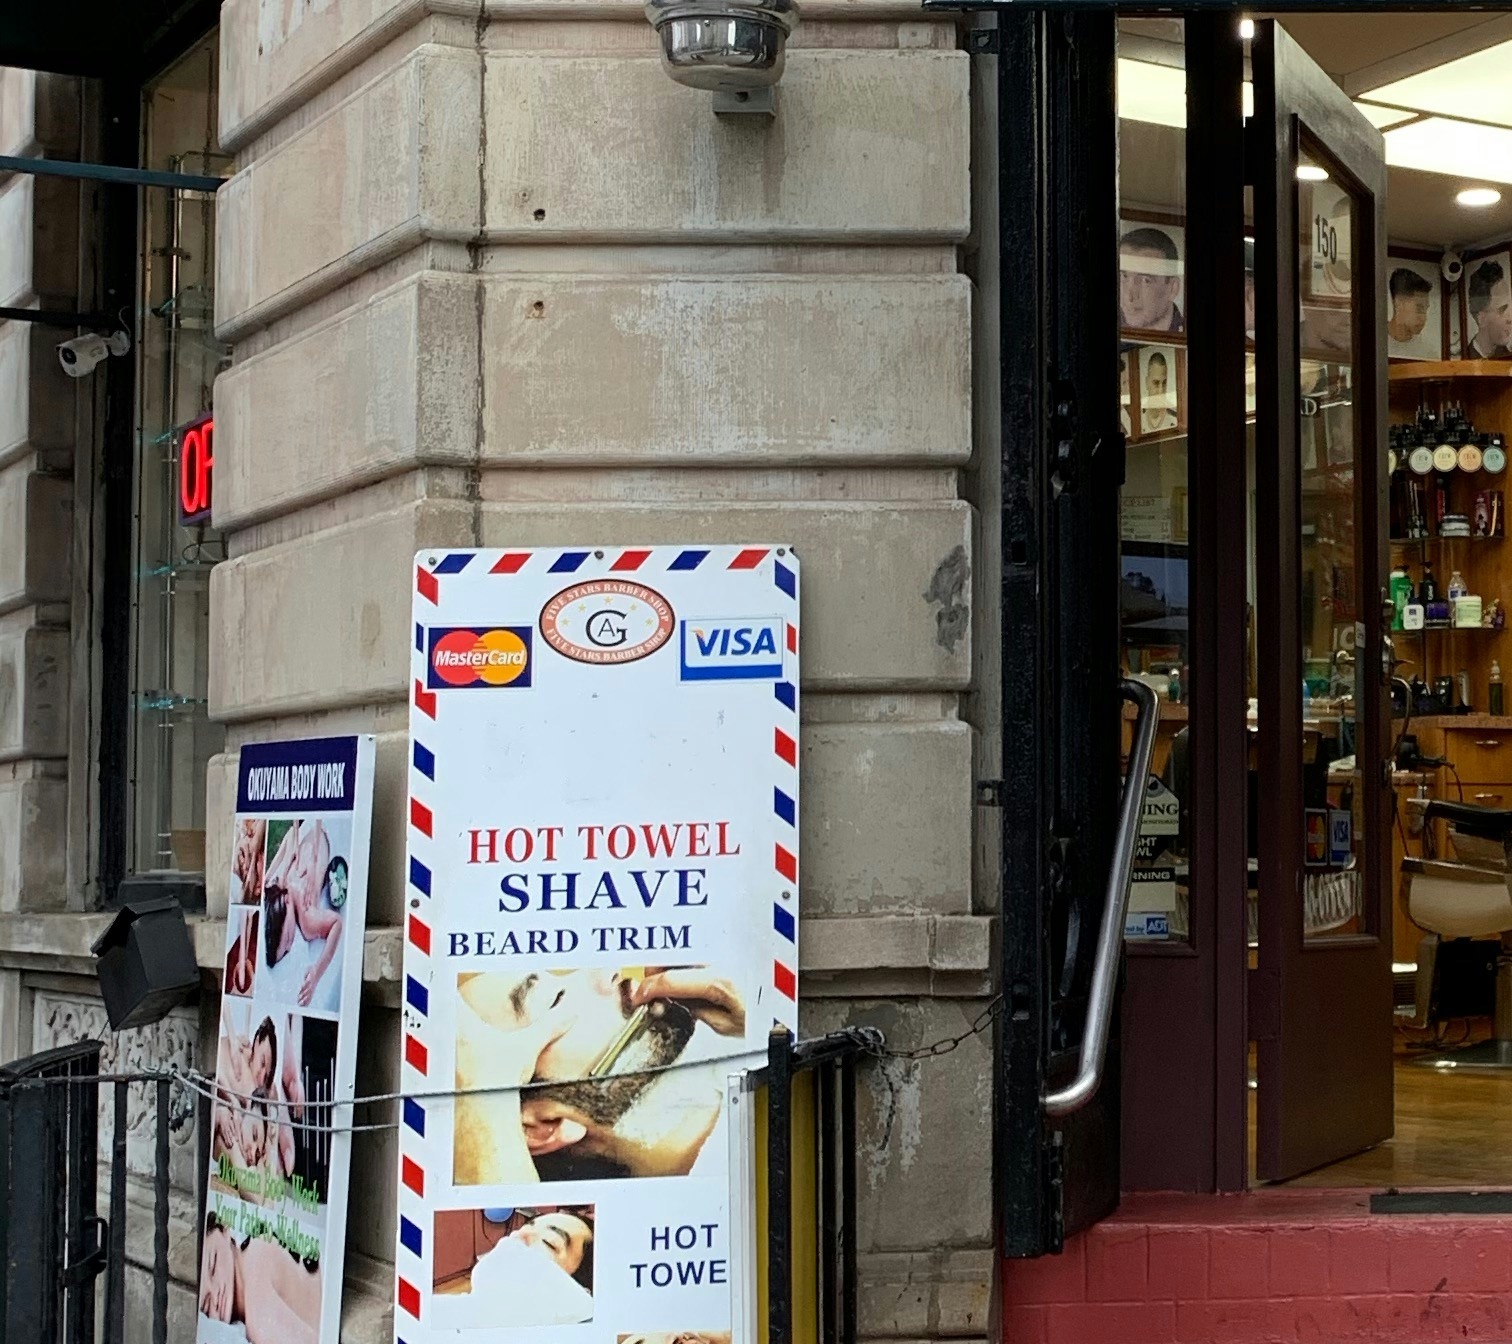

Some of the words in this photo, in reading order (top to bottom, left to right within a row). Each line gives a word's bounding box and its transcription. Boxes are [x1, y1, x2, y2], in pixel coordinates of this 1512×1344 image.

[1315, 214, 1337, 265] 150
[567, 584, 601, 602] STARS
[692, 627, 776, 656] VISA
[435, 649, 525, 666] MasterCard
[248, 766, 289, 801] OKUYAMA
[291, 764, 316, 800] BODY
[317, 762, 345, 799] WORK
[467, 827, 563, 864] HOT
[578, 821, 741, 860] TOWEL
[498, 868, 709, 913] SHAVE
[448, 929, 579, 957] BEARD
[592, 924, 692, 952] TRIM
[651, 1224, 719, 1251] HOT
[629, 1259, 727, 1288] TOWE
